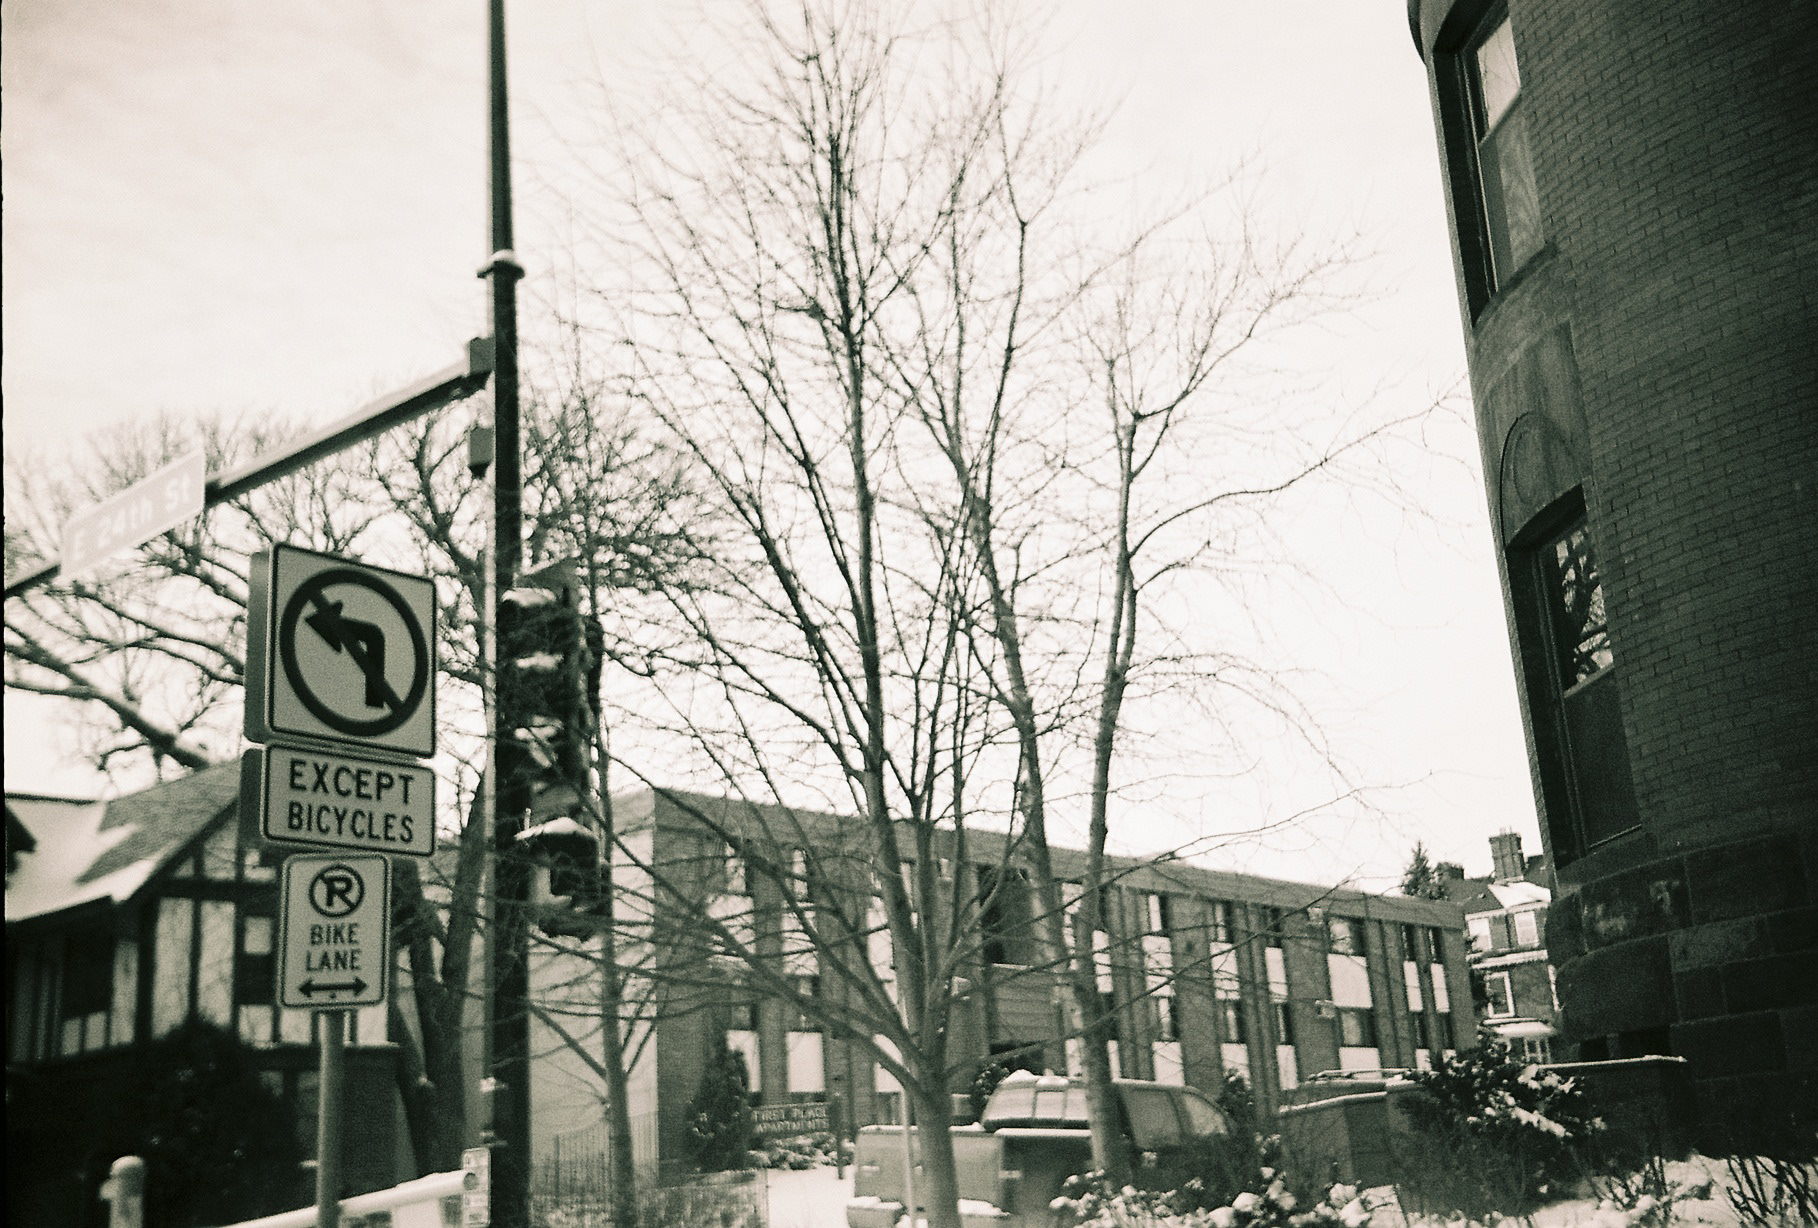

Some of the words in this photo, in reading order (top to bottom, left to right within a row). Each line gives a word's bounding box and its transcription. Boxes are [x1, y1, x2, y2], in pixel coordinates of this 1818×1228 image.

[97, 496, 153, 551] 24th
[165, 470, 191, 513] St
[290, 758, 414, 804] EXCEPT
[288, 802, 413, 843] BICYCLES
[310, 923, 361, 946] BIKE
[305, 950, 361, 972] LANE
